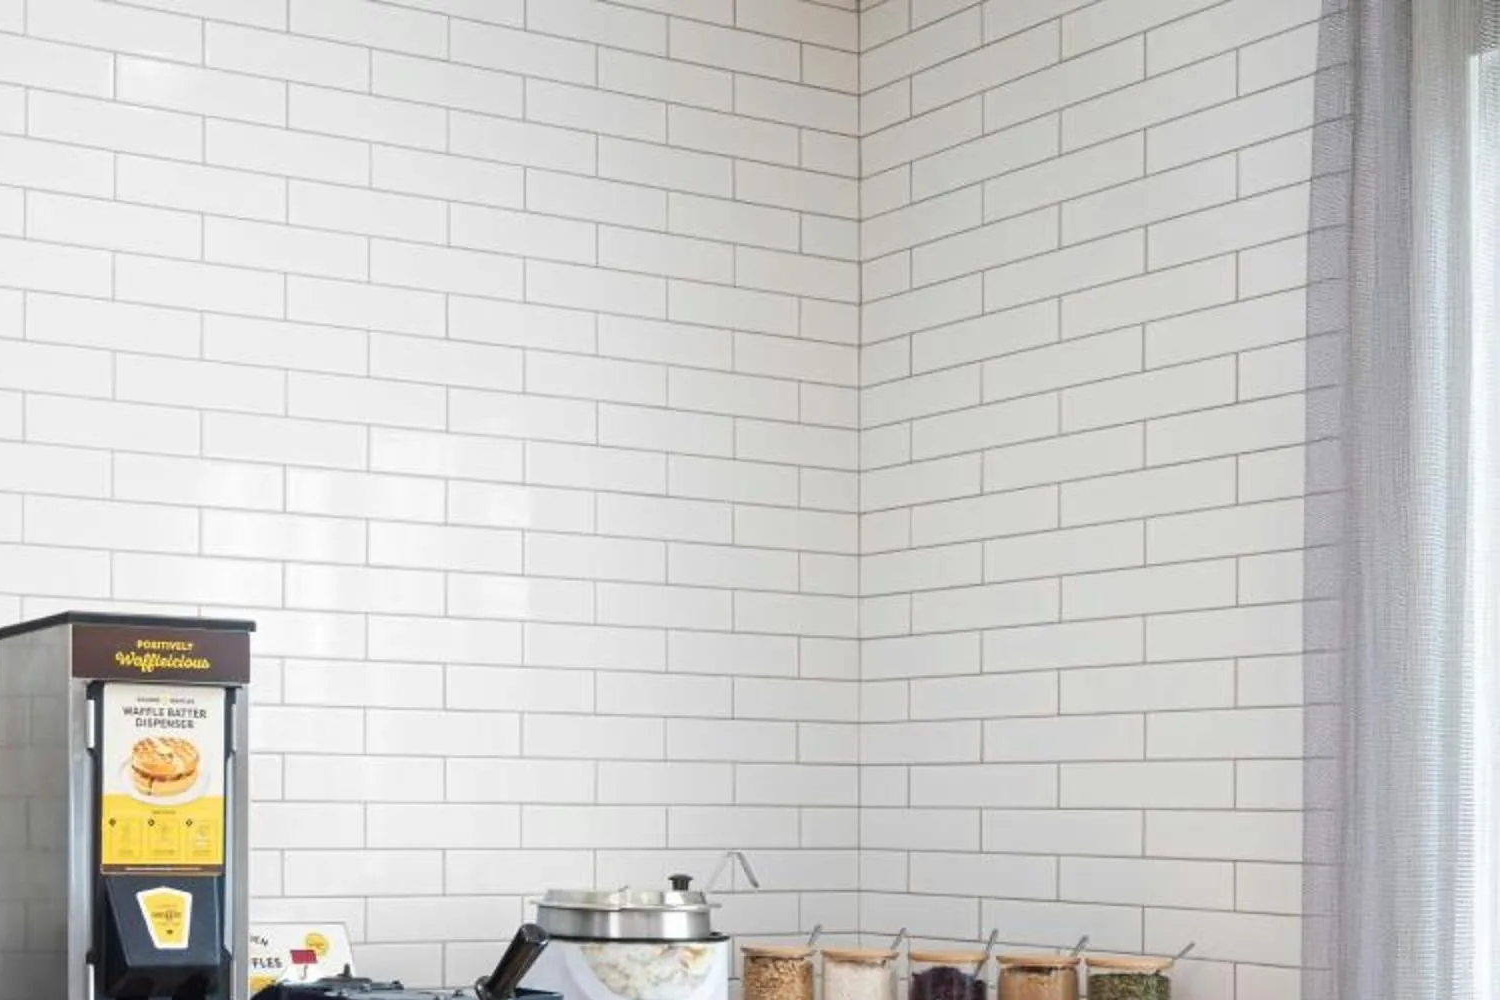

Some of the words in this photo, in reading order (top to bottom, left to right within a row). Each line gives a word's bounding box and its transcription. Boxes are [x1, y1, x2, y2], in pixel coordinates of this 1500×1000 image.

[137, 639, 195, 651] POSITIVELY
[122, 706, 165, 717] WAFFLE
[167, 707, 207, 719] BATTER
[135, 717, 195, 729] DISPENSER
[250, 957, 283, 969] FLES
